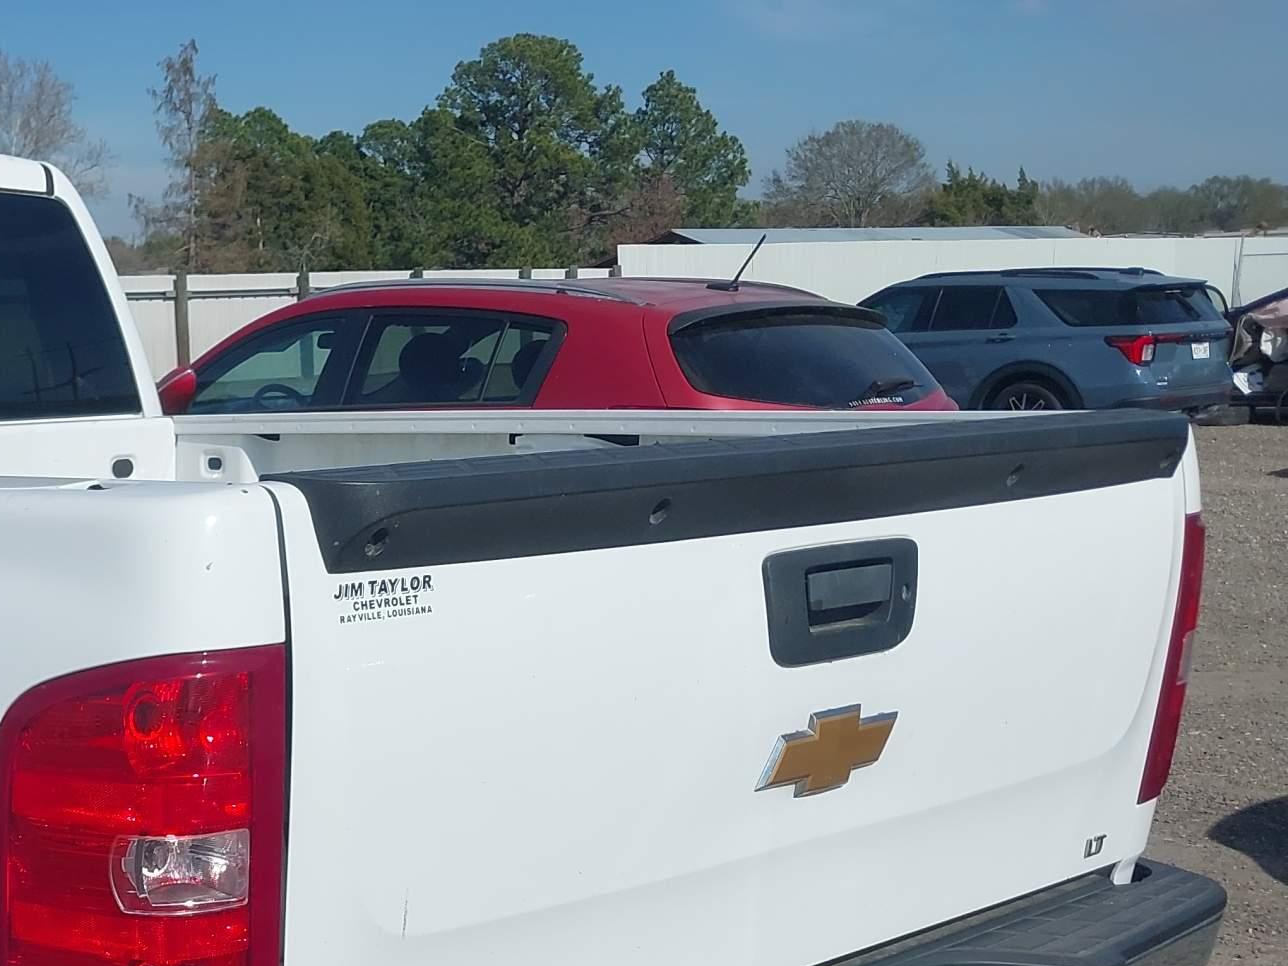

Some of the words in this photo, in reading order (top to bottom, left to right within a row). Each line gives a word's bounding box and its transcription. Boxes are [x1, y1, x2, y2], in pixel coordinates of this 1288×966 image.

[333, 582, 364, 601] JIM
[368, 575, 434, 597] TAYLOR
[353, 594, 419, 611] CHEVROLET
[339, 611, 385, 624] RAYVILLE,
[387, 605, 433, 618] LOUISIANA
[1084, 834, 1108, 859] LT
